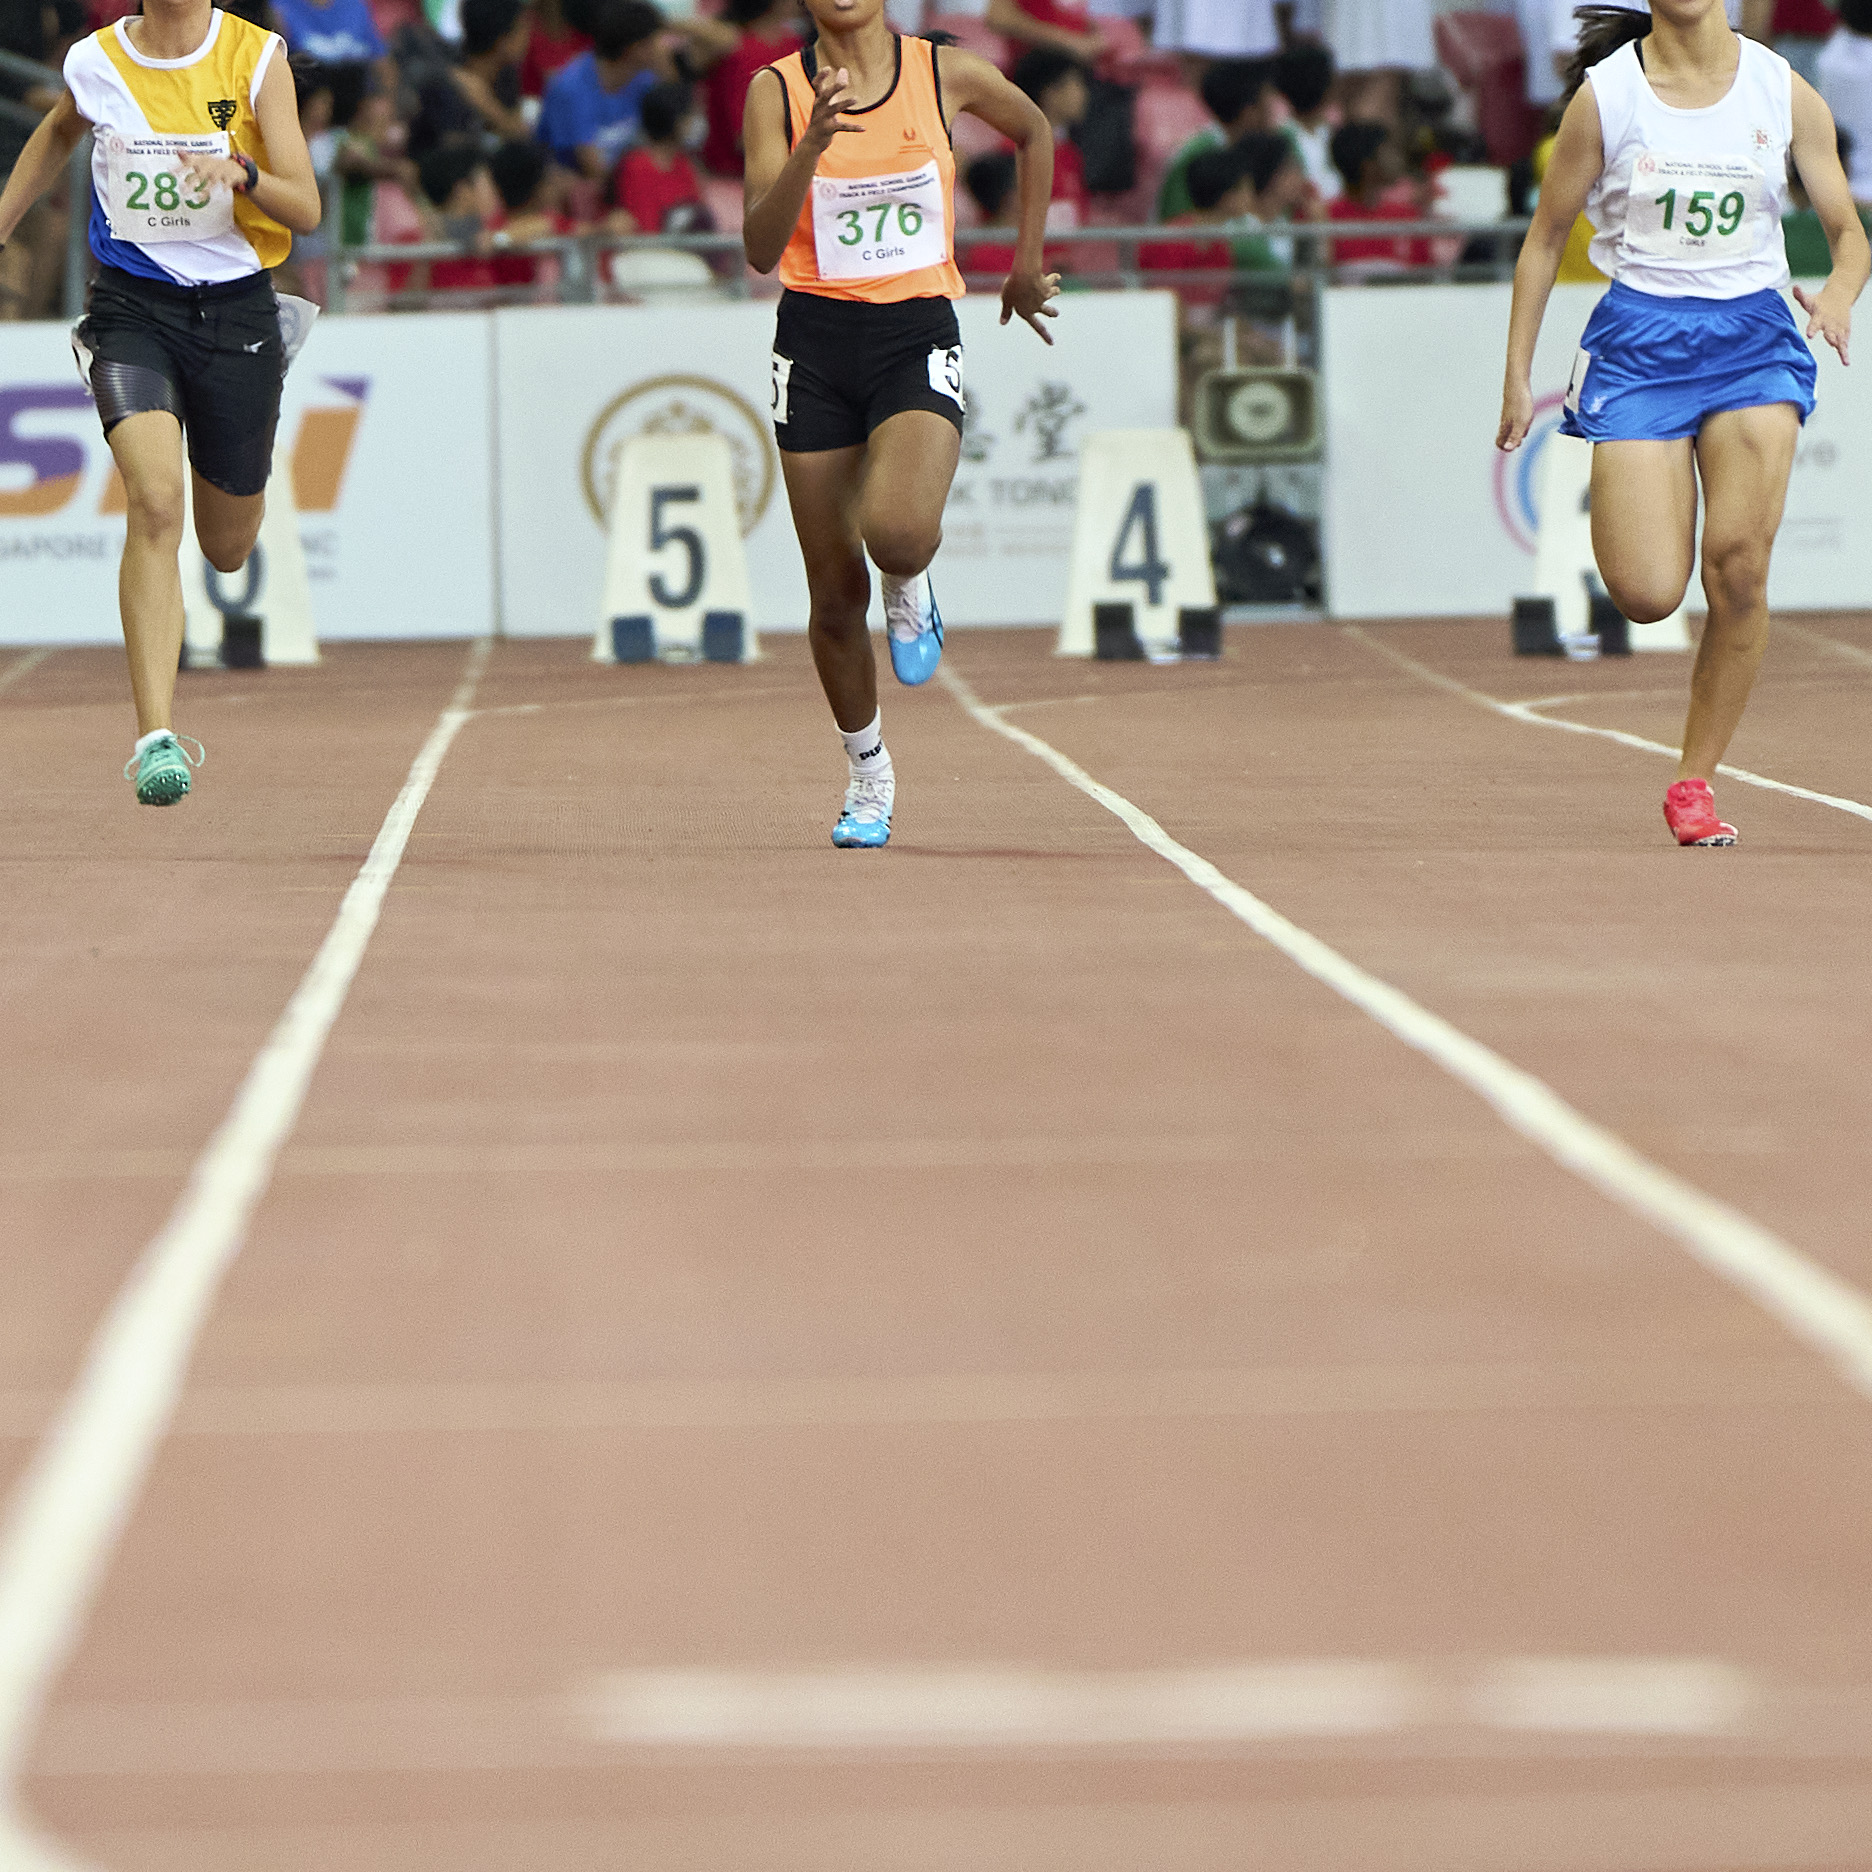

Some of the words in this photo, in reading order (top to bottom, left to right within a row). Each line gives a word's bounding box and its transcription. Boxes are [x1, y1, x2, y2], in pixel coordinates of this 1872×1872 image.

[125, 171, 211, 211] 283
[1655, 188, 1745, 237] 159
[147, 217, 157, 227] C
[161, 216, 191, 227] Girls
[836, 202, 923, 246] 376
[862, 250, 872, 261] C
[876, 247, 905, 259] Girls
[648, 484, 706, 610] 5
[1110, 481, 1172, 607] 4
